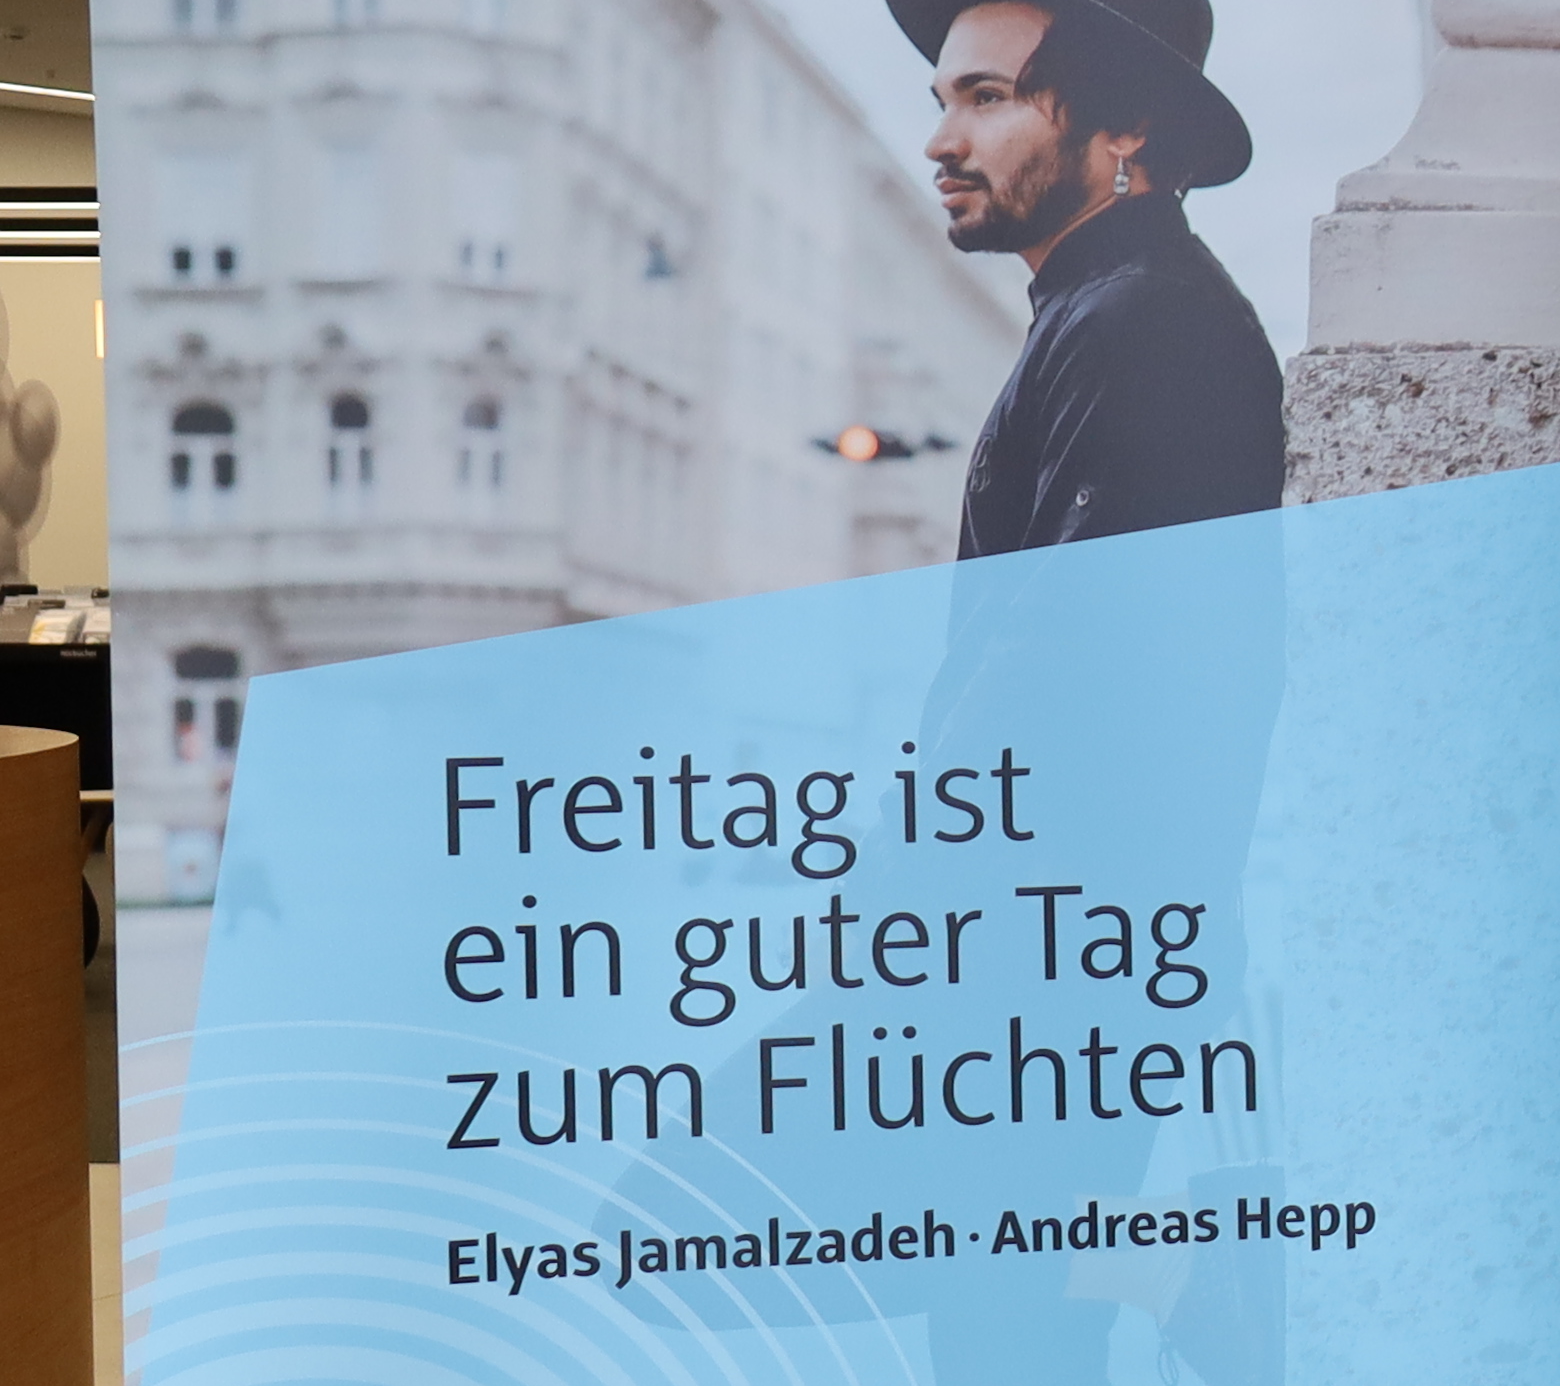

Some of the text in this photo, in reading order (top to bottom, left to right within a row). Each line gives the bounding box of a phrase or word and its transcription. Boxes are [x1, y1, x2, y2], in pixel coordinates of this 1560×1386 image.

[443, 740, 1034, 878] Freitag ist
[442, 885, 1208, 1028] ein guter Tag
[447, 1017, 1262, 1150] zum Flüchten
[447, 1194, 1378, 1295] Elyas Jamalzadeh Andreas Hepp
